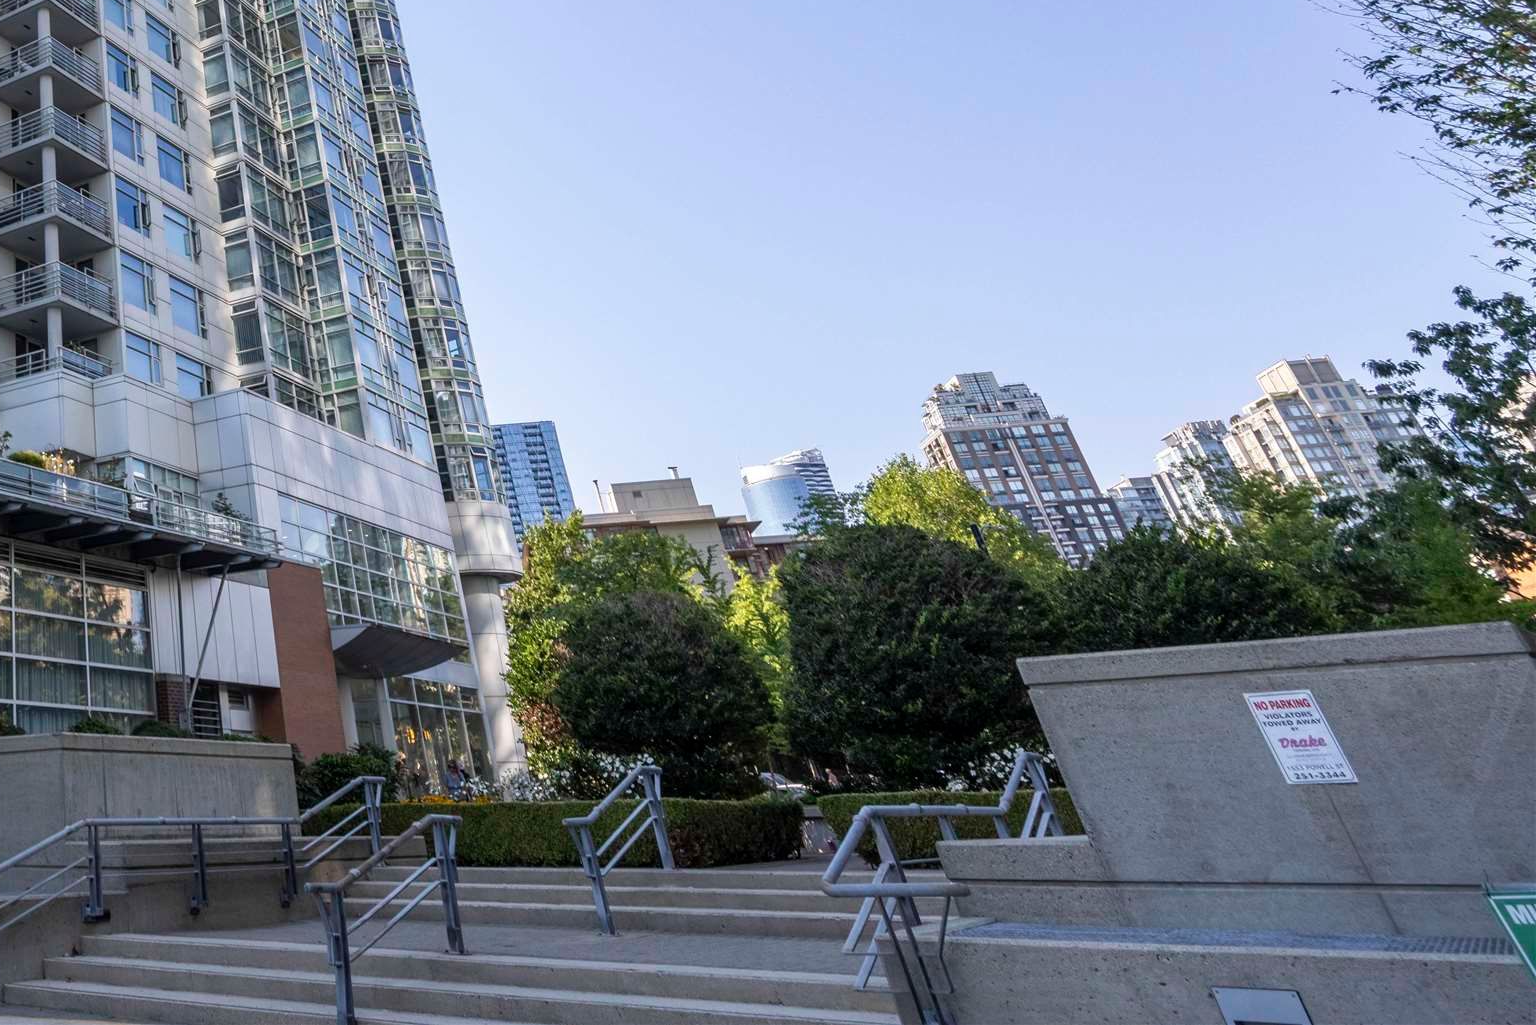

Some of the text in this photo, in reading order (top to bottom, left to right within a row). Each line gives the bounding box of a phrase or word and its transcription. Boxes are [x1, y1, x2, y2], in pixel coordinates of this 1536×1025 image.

[1253, 698, 1311, 711] NO PARKING
[1264, 711, 1312, 719] VIOLATORS
[1263, 718, 1321, 727] TOWED AWAY
[1279, 735, 1327, 748] Drake
[1295, 771, 1346, 780] 251-3344
